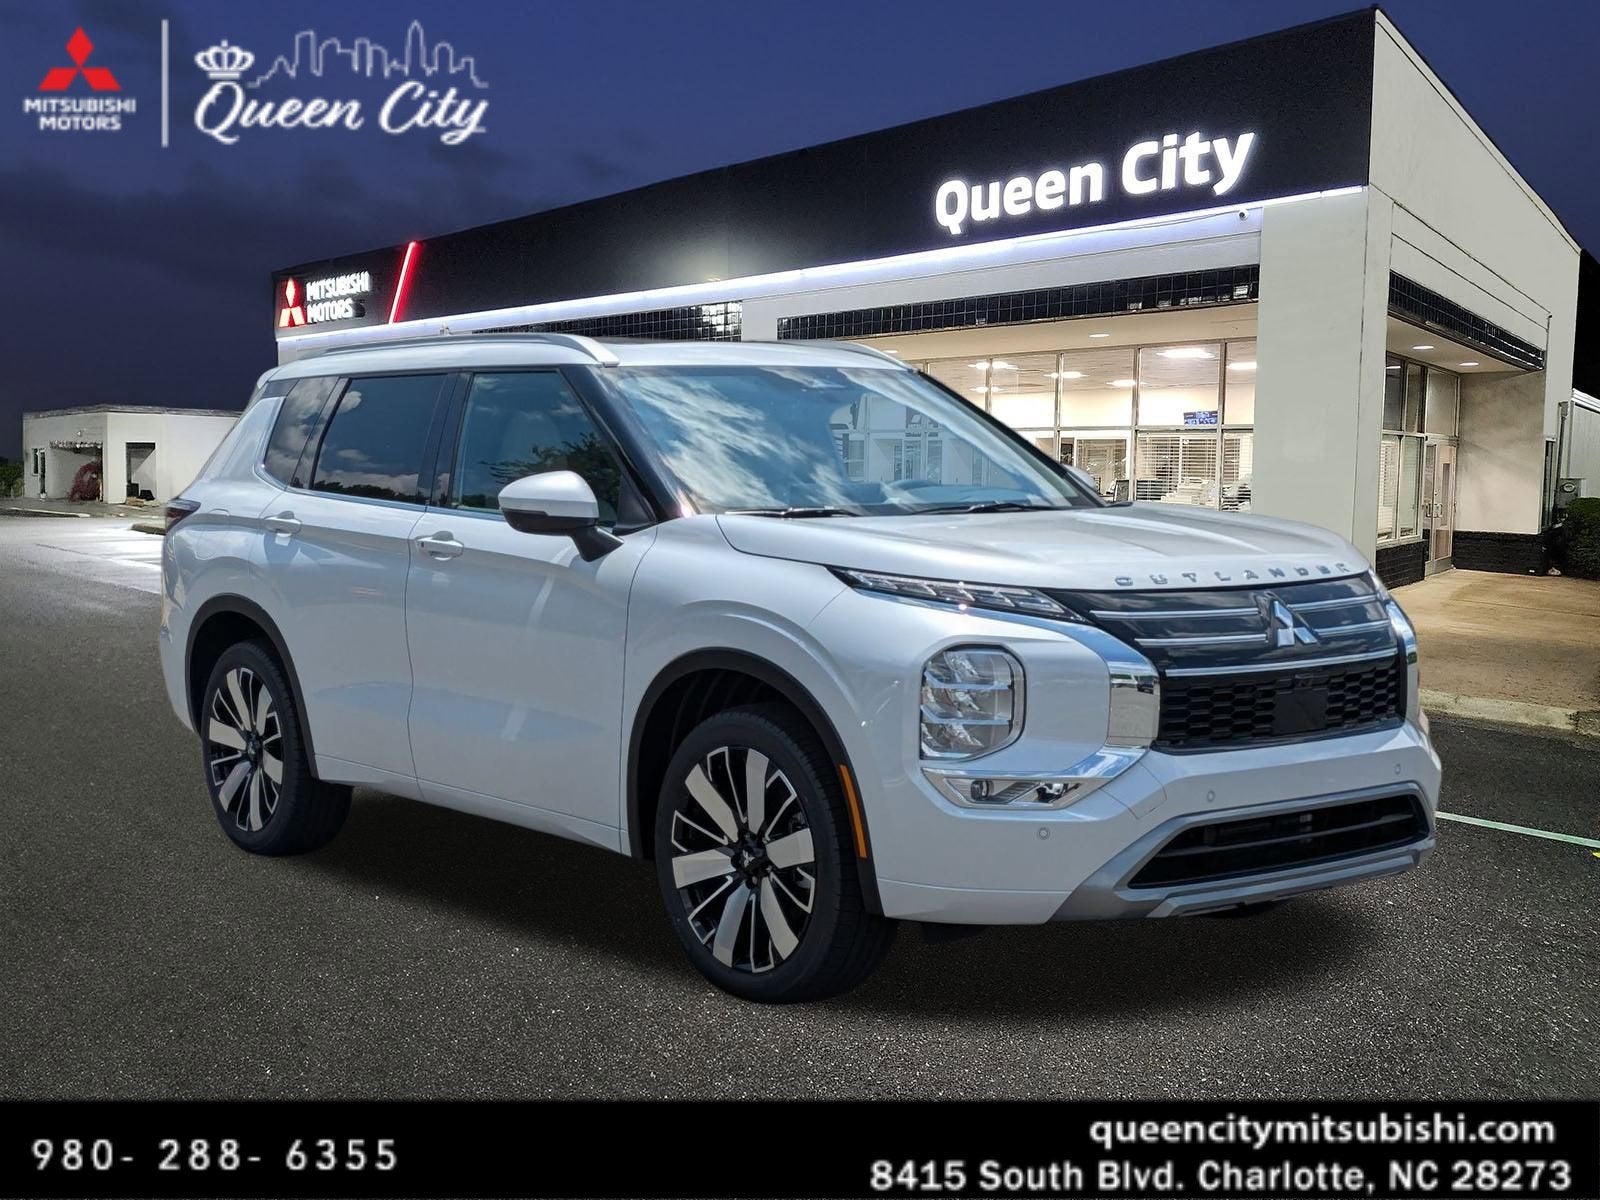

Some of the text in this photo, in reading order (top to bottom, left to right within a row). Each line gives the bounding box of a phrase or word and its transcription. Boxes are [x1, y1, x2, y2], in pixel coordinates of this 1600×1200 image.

[935, 131, 1256, 235] Queen City
[305, 270, 371, 302] MITSUBISHI
[305, 298, 355, 324] MOTORS
[1114, 562, 1351, 587] OUTLANDER
